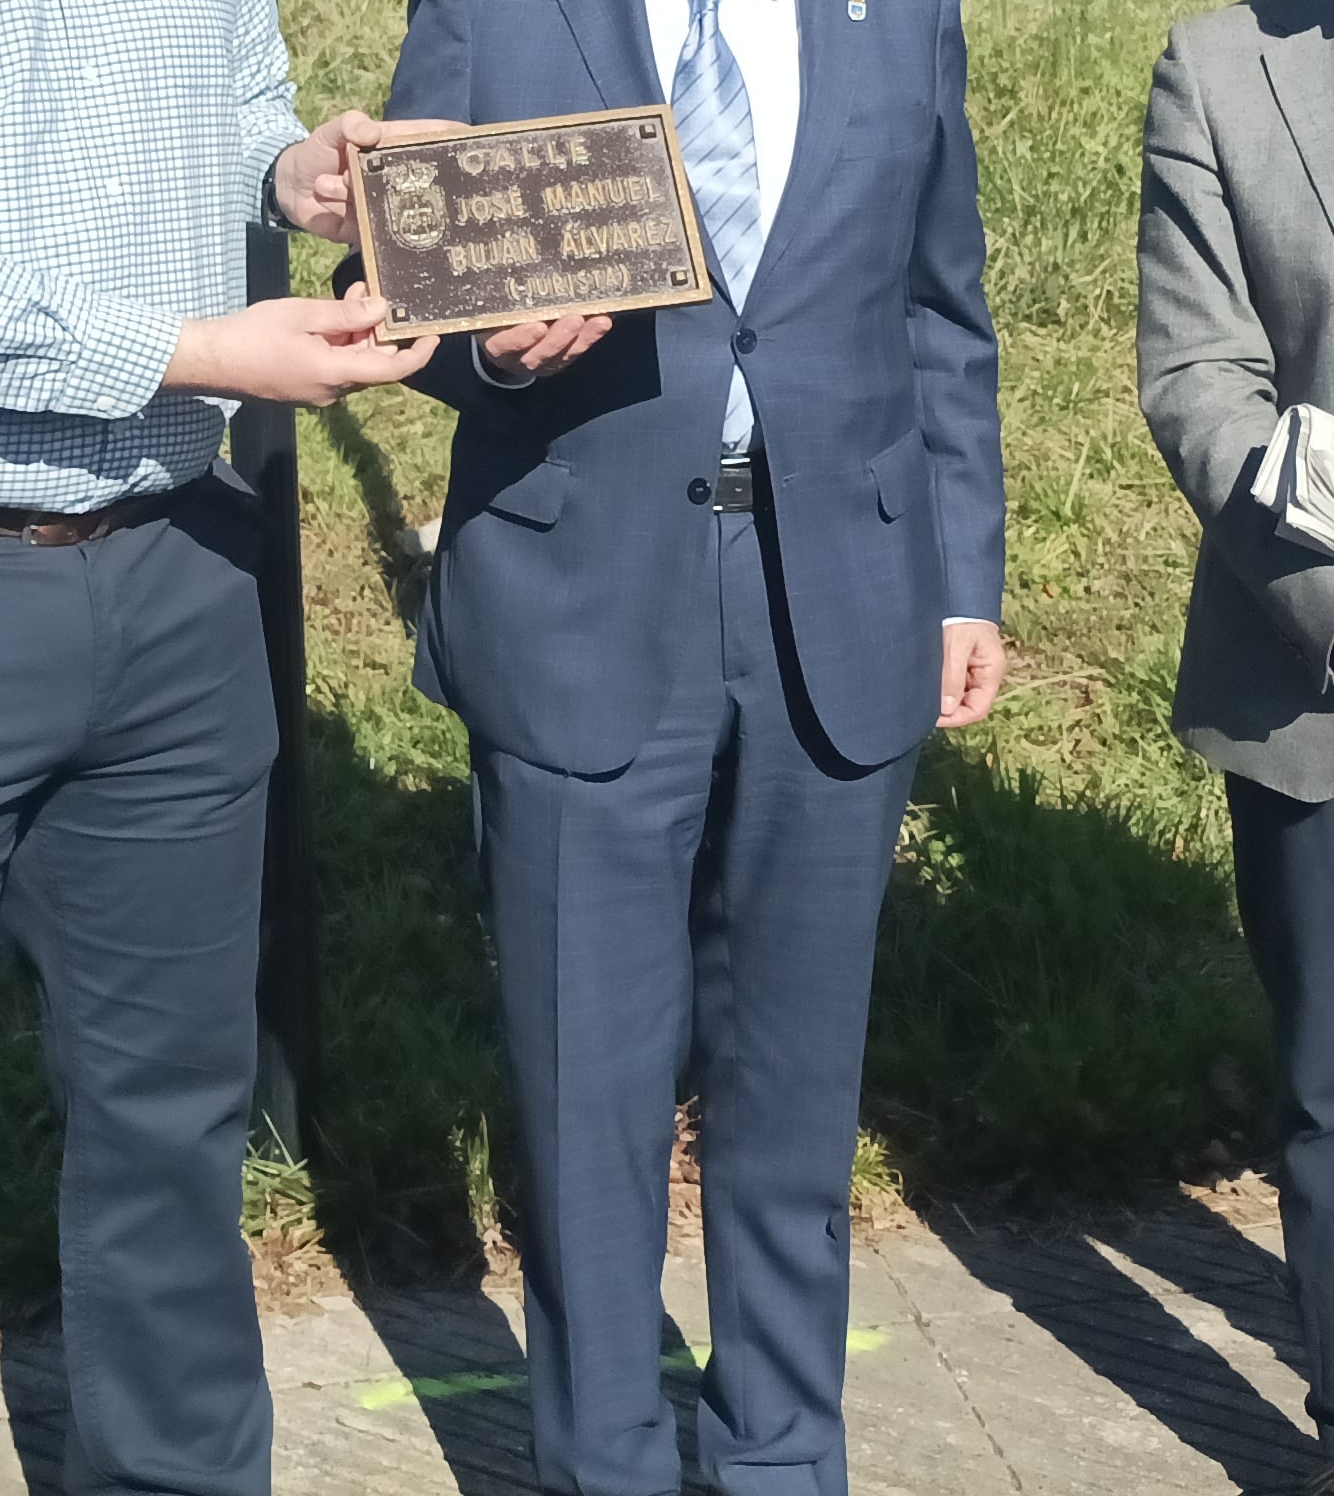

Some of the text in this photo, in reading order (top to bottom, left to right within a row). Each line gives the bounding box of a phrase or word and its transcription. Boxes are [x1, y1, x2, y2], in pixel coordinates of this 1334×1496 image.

[460, 137, 590, 175] CALLE
[457, 176, 663, 225] JOSÉ MANUEL
[449, 219, 680, 274] BUJÁN ÁLVAREZ
[506, 264, 631, 301] (JURISTA)
